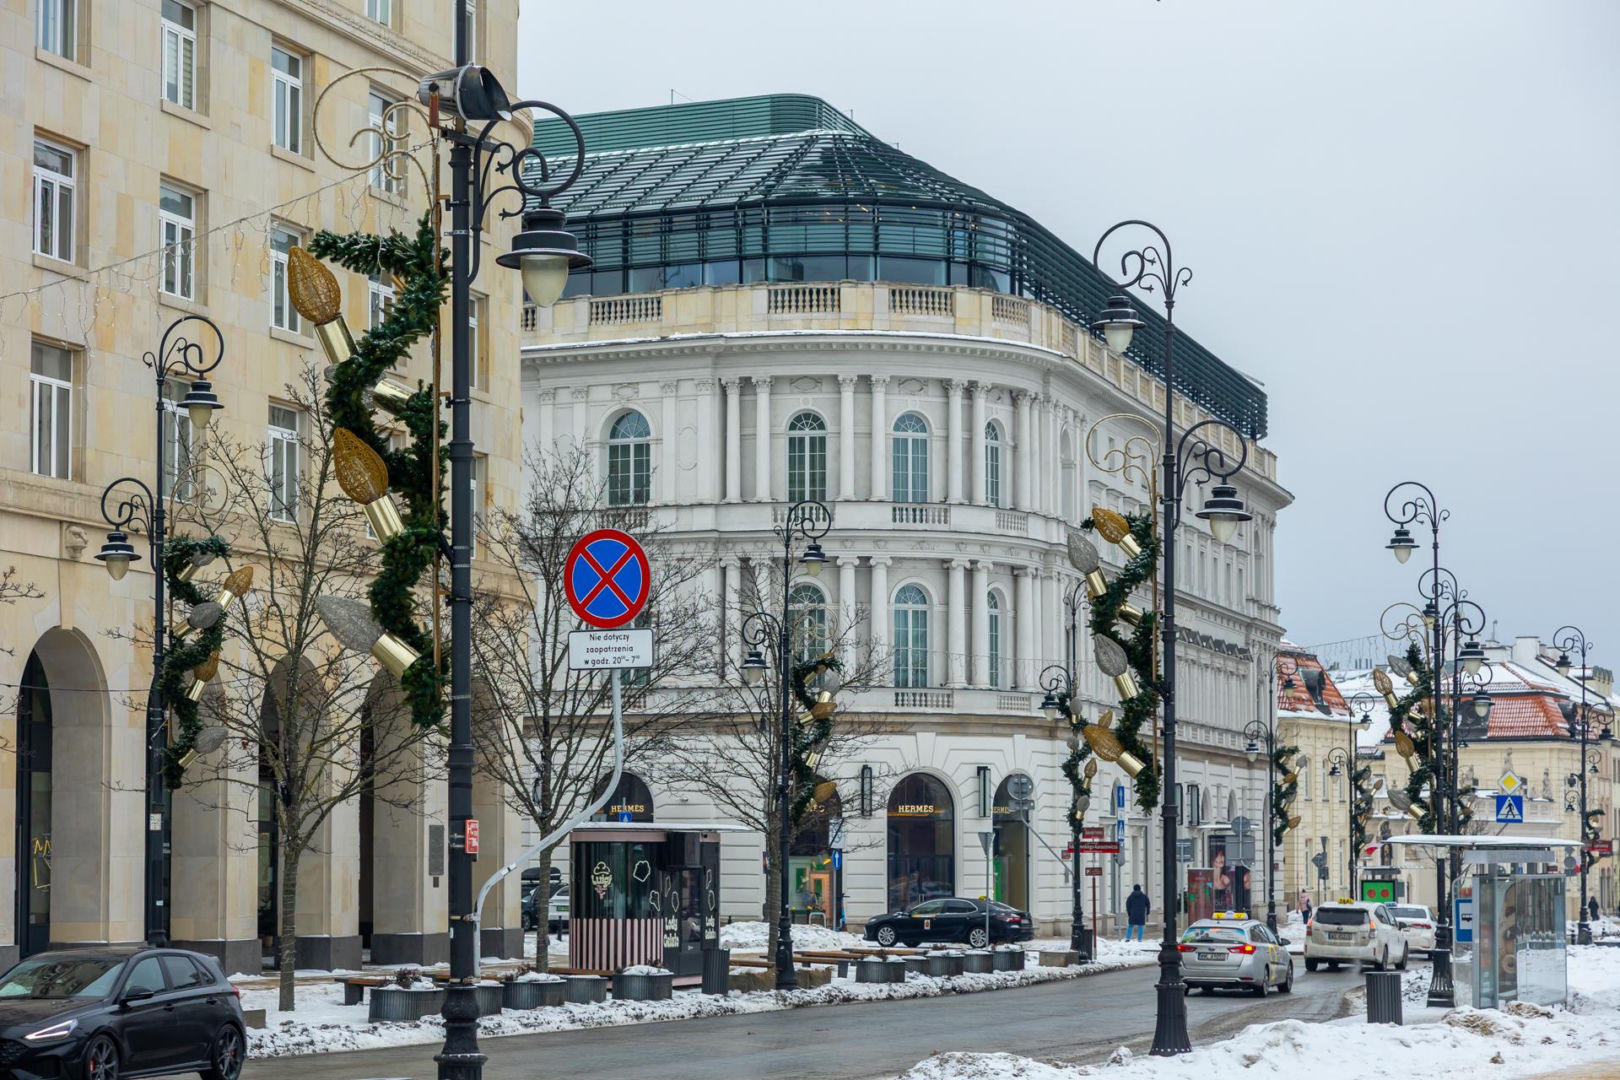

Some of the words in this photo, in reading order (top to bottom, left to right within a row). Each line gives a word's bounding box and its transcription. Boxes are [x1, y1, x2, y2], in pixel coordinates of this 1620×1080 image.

[603, 633, 629, 642] dotyczy
[586, 645, 634, 655] zaopatrzenia
[591, 657, 611, 667] godz.
